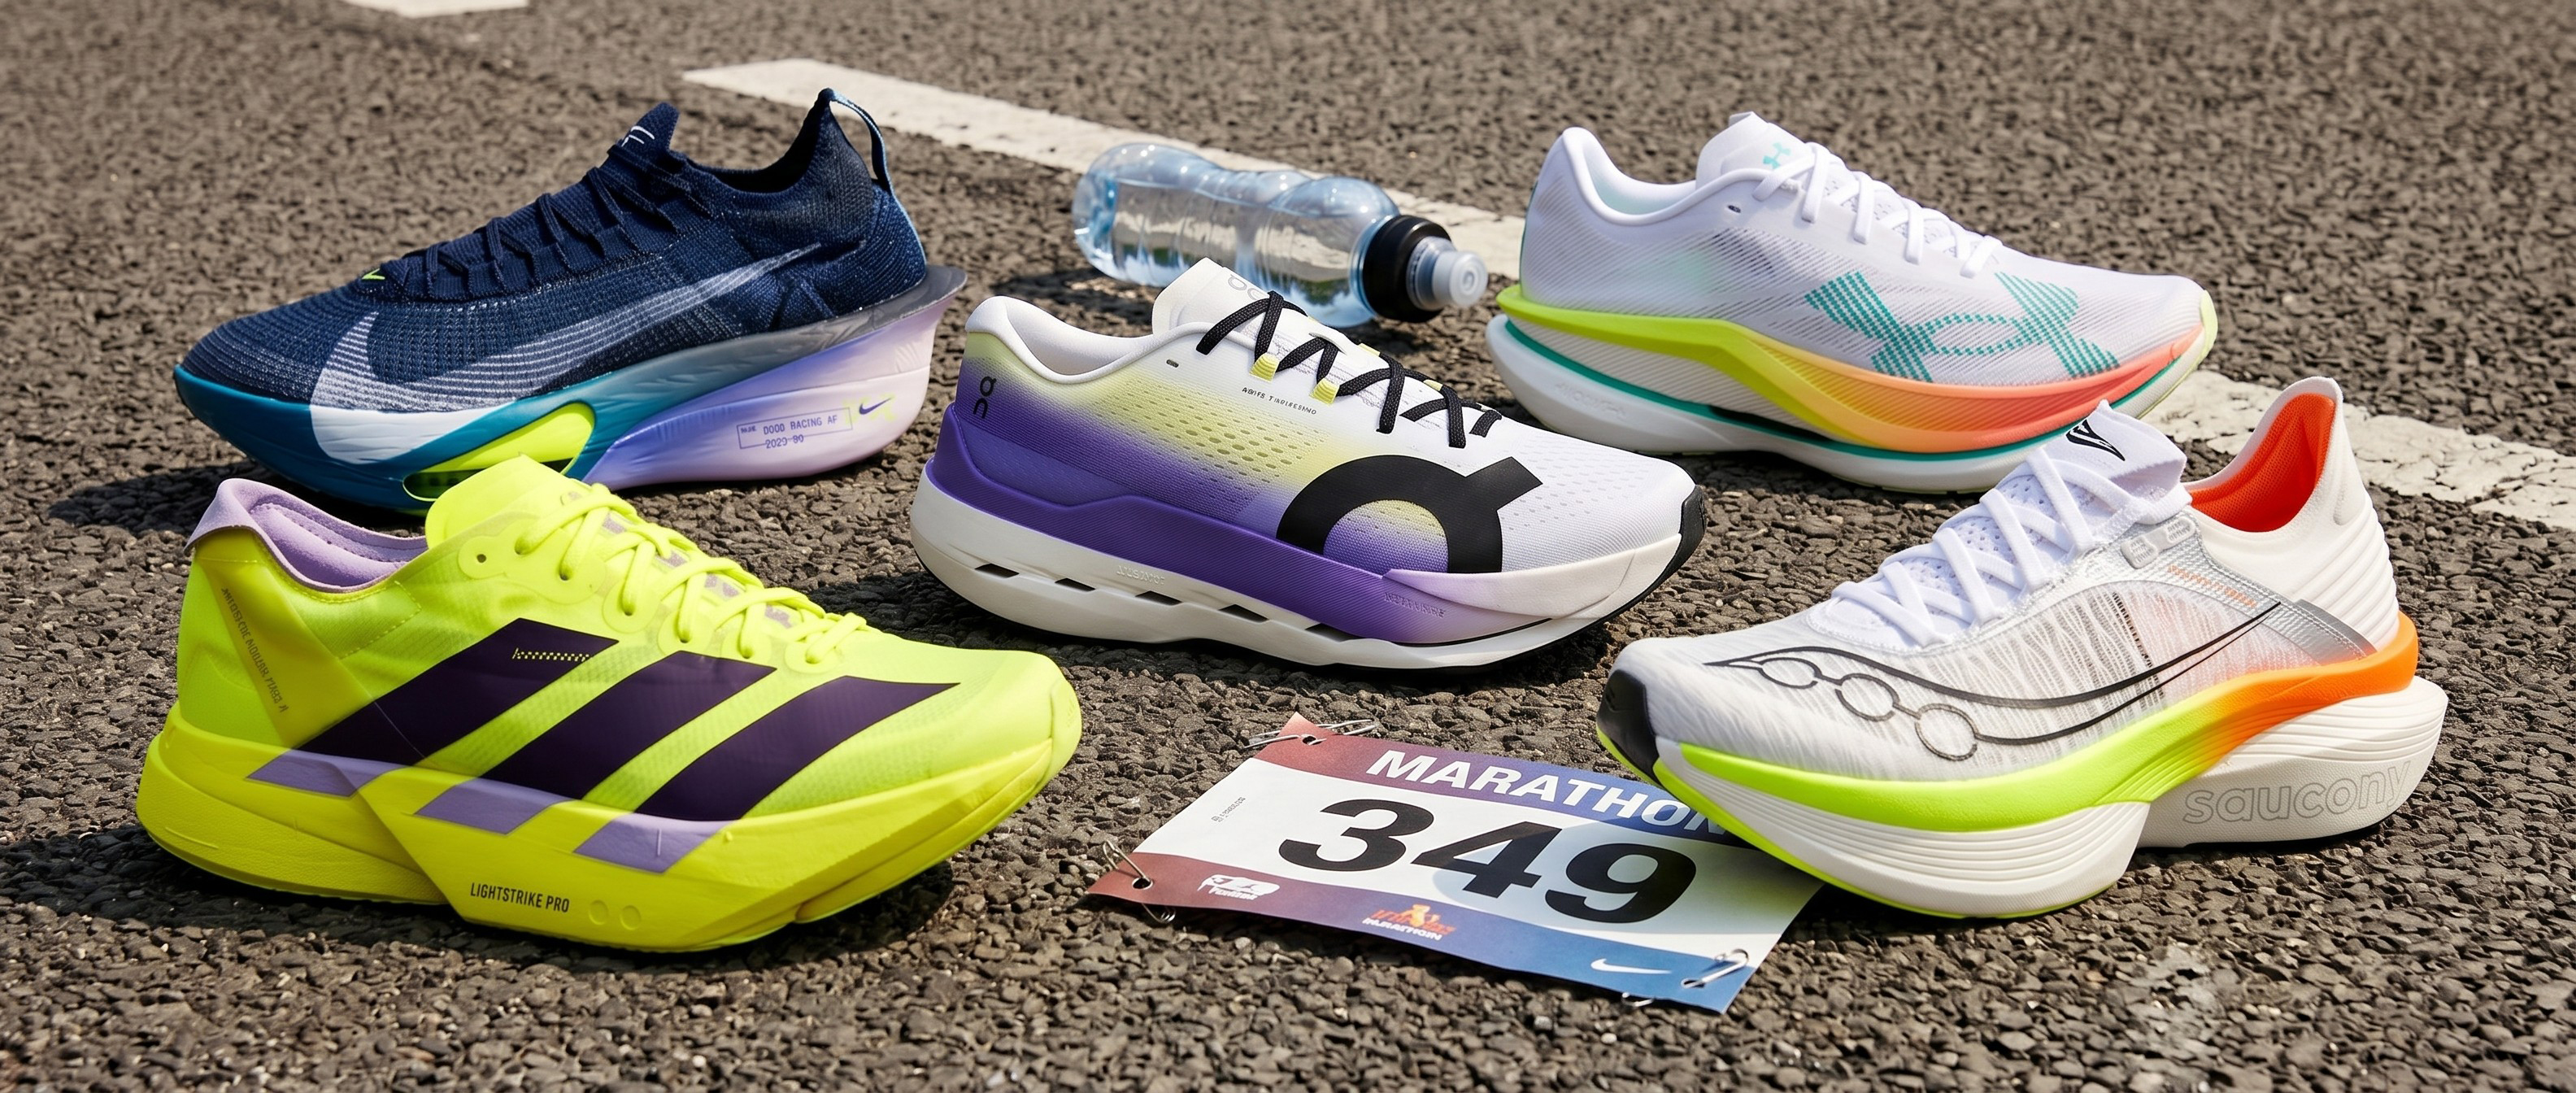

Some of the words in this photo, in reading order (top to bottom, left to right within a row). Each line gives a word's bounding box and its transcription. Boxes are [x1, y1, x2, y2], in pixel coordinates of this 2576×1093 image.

[790, 416, 822, 430] RACING
[828, 415, 838, 425] AF
[2182, 760, 2411, 825] saucony
[1279, 799, 1697, 924] 349
[470, 882, 542, 908] LIGHTSTRIKE
[546, 895, 570, 912] PRO
